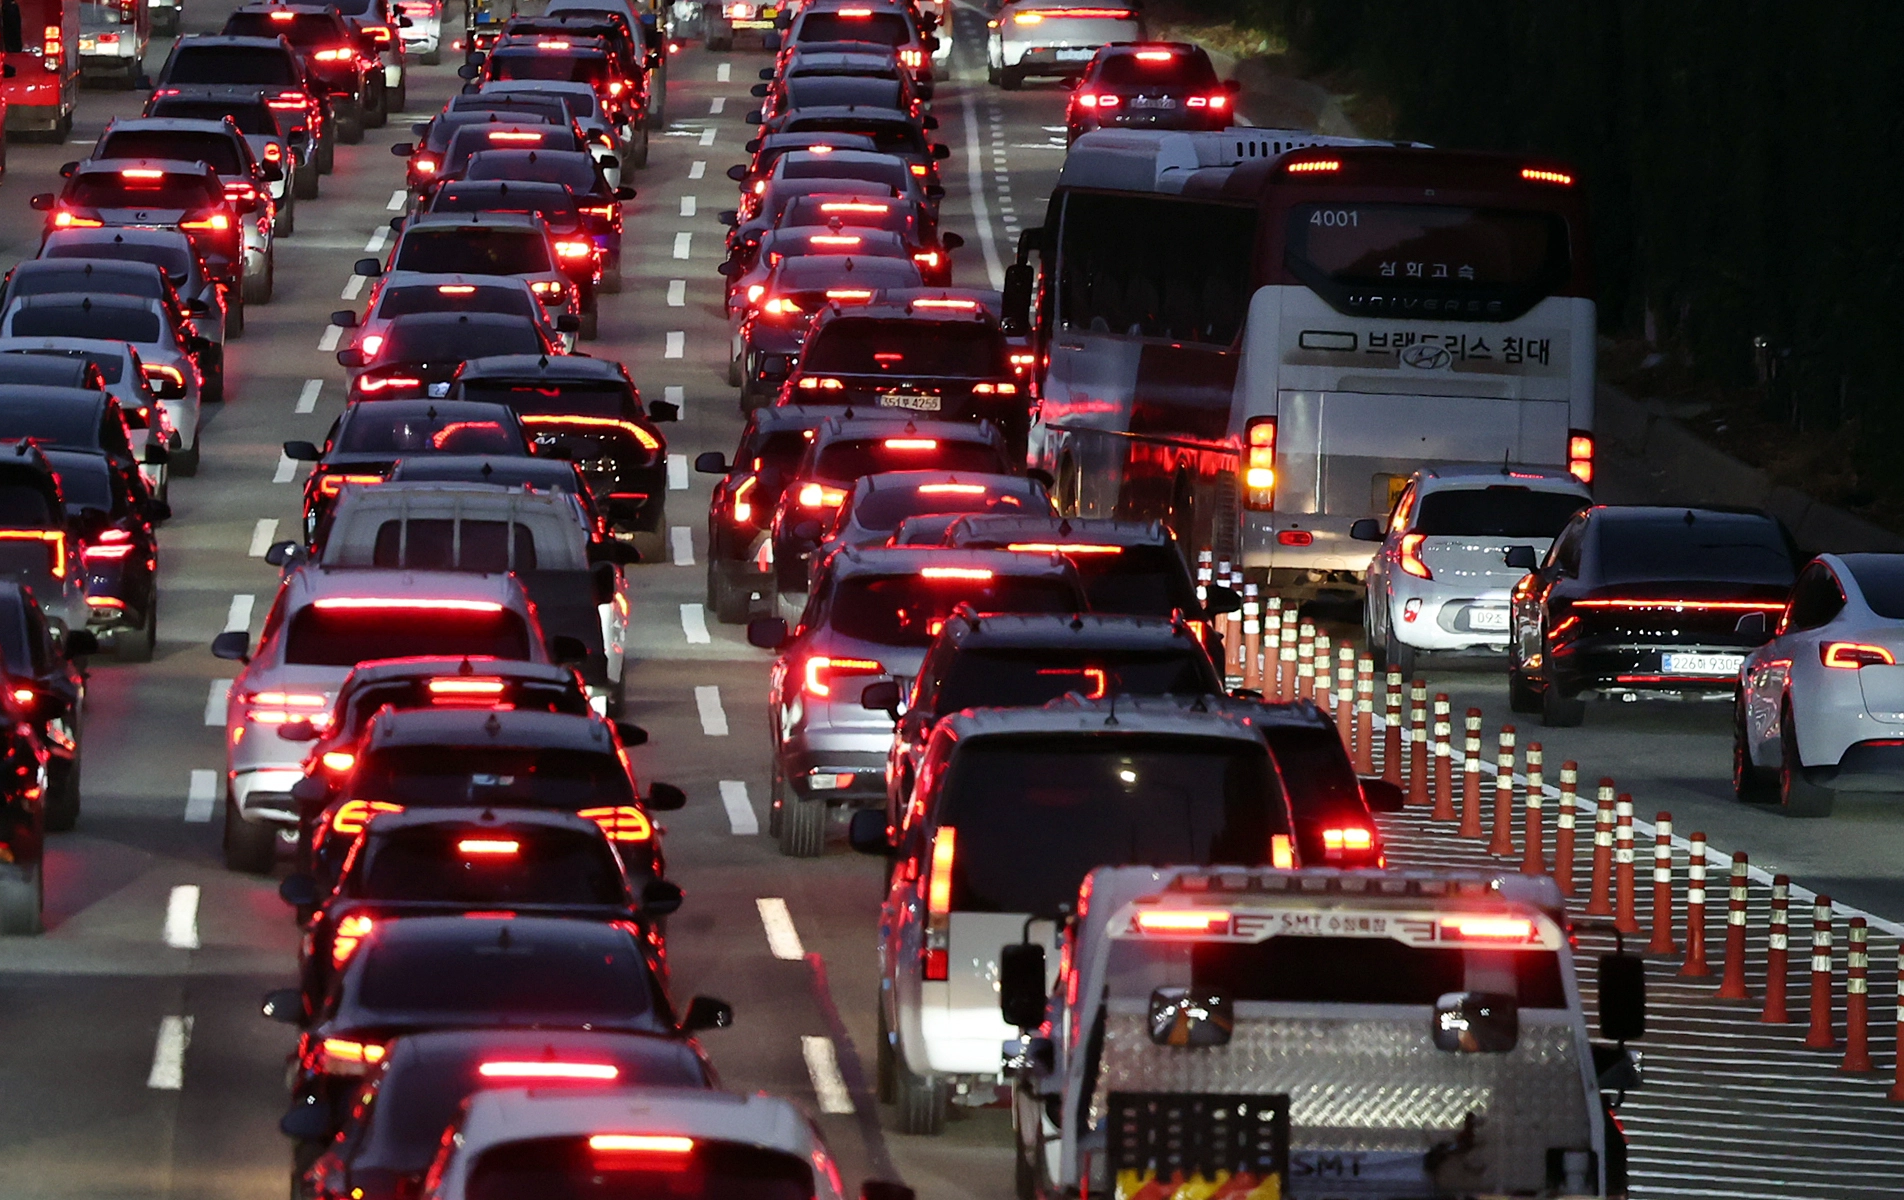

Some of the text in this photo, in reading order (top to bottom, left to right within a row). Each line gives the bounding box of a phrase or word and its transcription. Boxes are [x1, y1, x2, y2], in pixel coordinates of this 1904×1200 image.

[1309, 210, 1359, 228] 4001
[1348, 295, 1504, 312] UNIVERSE
[1501, 337, 1550, 366] 침대
[1709, 657, 1741, 671] 9305
[1282, 913, 1322, 930] SMT
[1290, 1151, 1368, 1177] SMT
